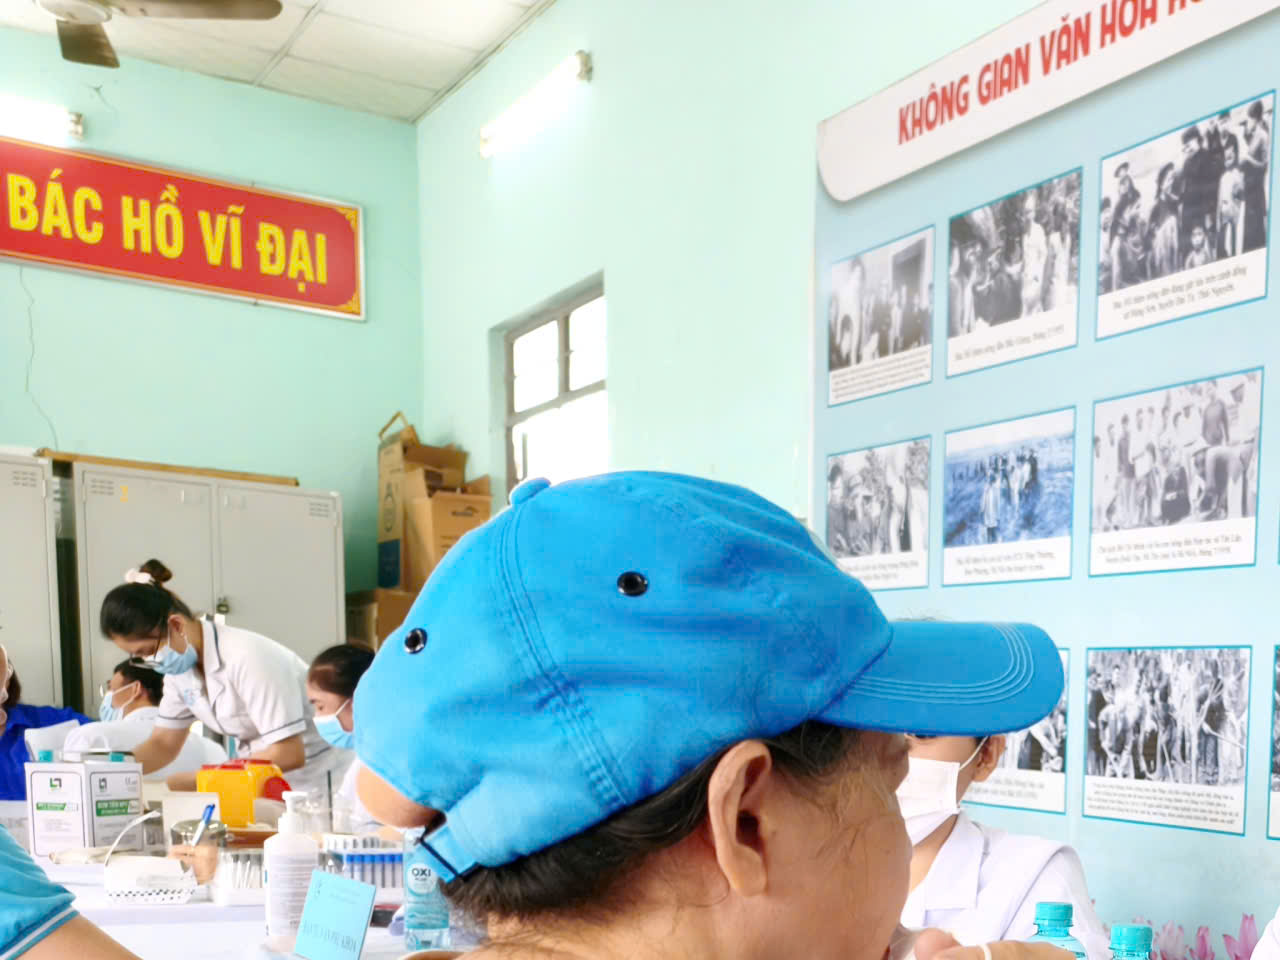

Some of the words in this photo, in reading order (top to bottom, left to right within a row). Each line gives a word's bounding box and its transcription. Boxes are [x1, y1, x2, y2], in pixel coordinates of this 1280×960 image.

[898, 83, 970, 145] KHÔNG
[977, 43, 1031, 106] GIAN
[1040, 13, 1092, 76] VĂN
[7, 168, 104, 244] BÁC
[121, 184, 184, 260] HỒ
[198, 205, 245, 270] VĨ
[256, 222, 327, 292] ĐẠI
[412, 867, 432, 878] OXI
